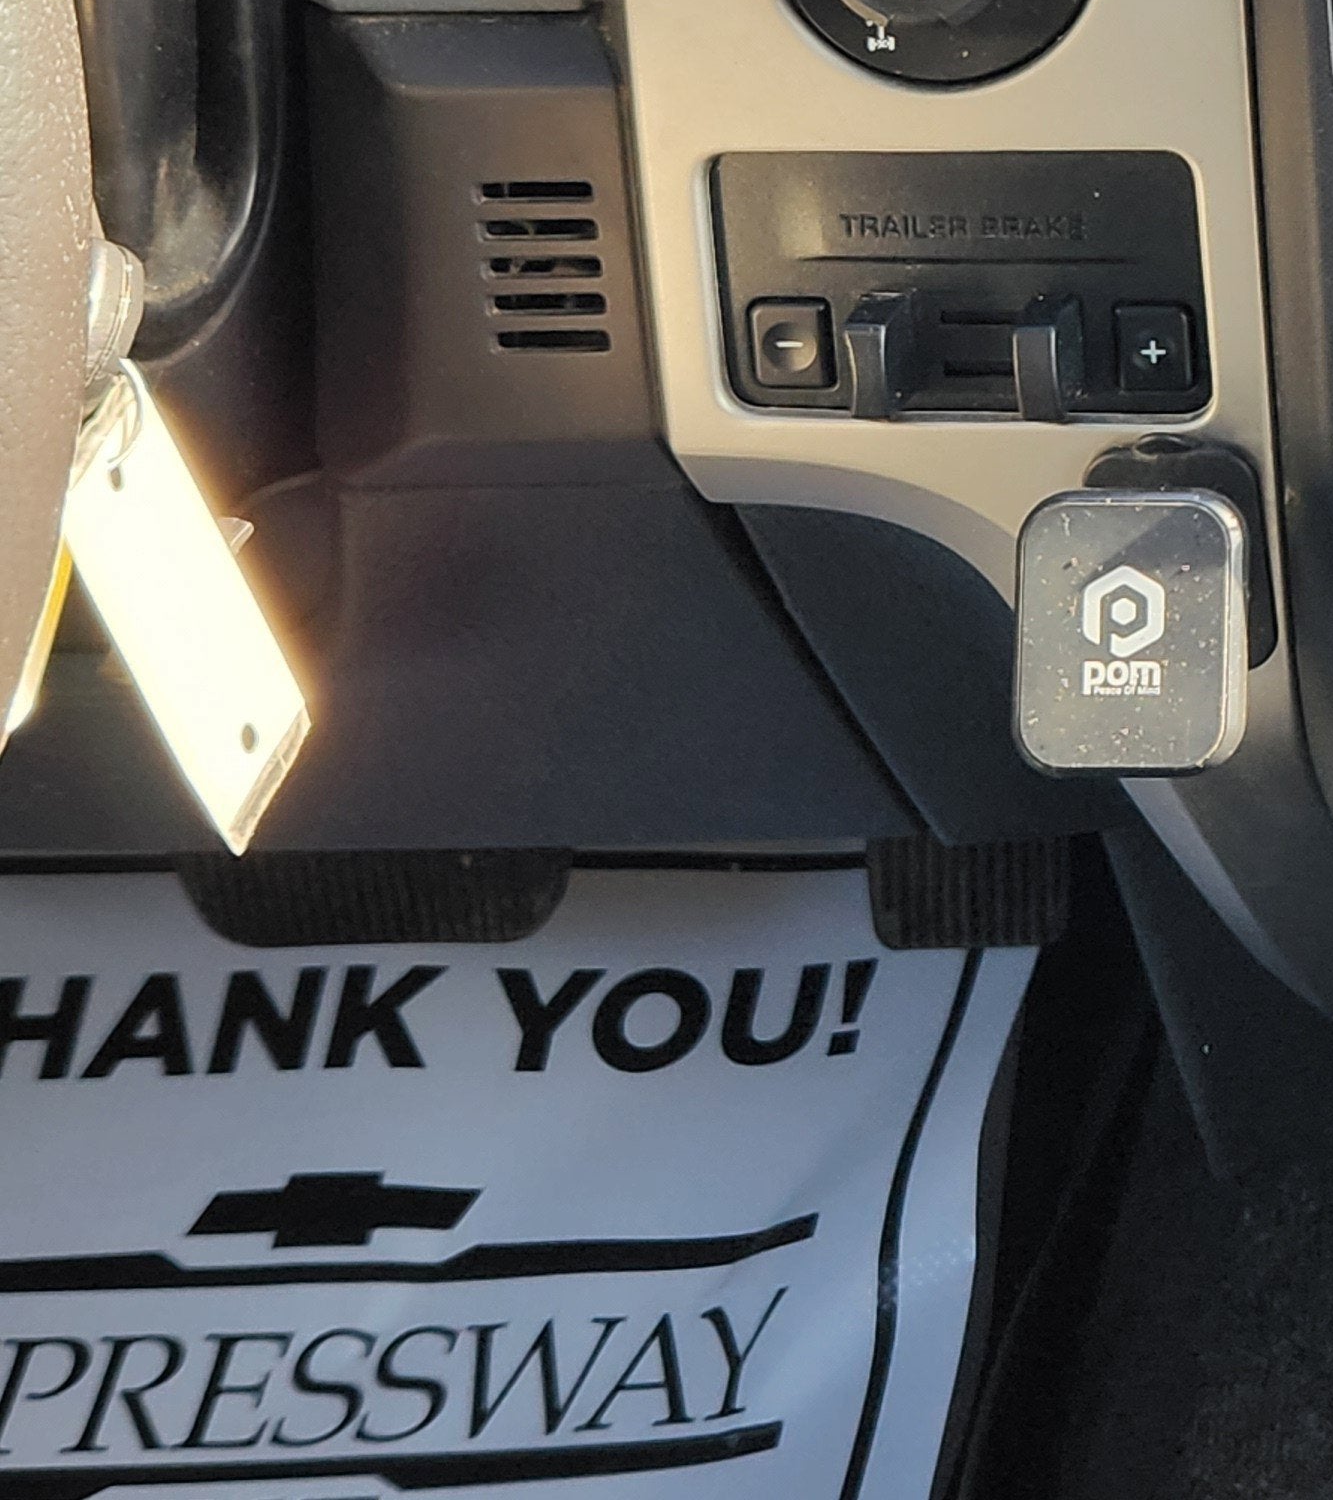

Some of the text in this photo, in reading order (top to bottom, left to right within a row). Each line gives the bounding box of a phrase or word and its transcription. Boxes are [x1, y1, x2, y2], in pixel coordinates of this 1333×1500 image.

[839, 213, 1086, 240] TRAILER BRAKE
[0, 958, 878, 1080] HANK YOU!
[0, 1287, 787, 1456] PRESSWAY
